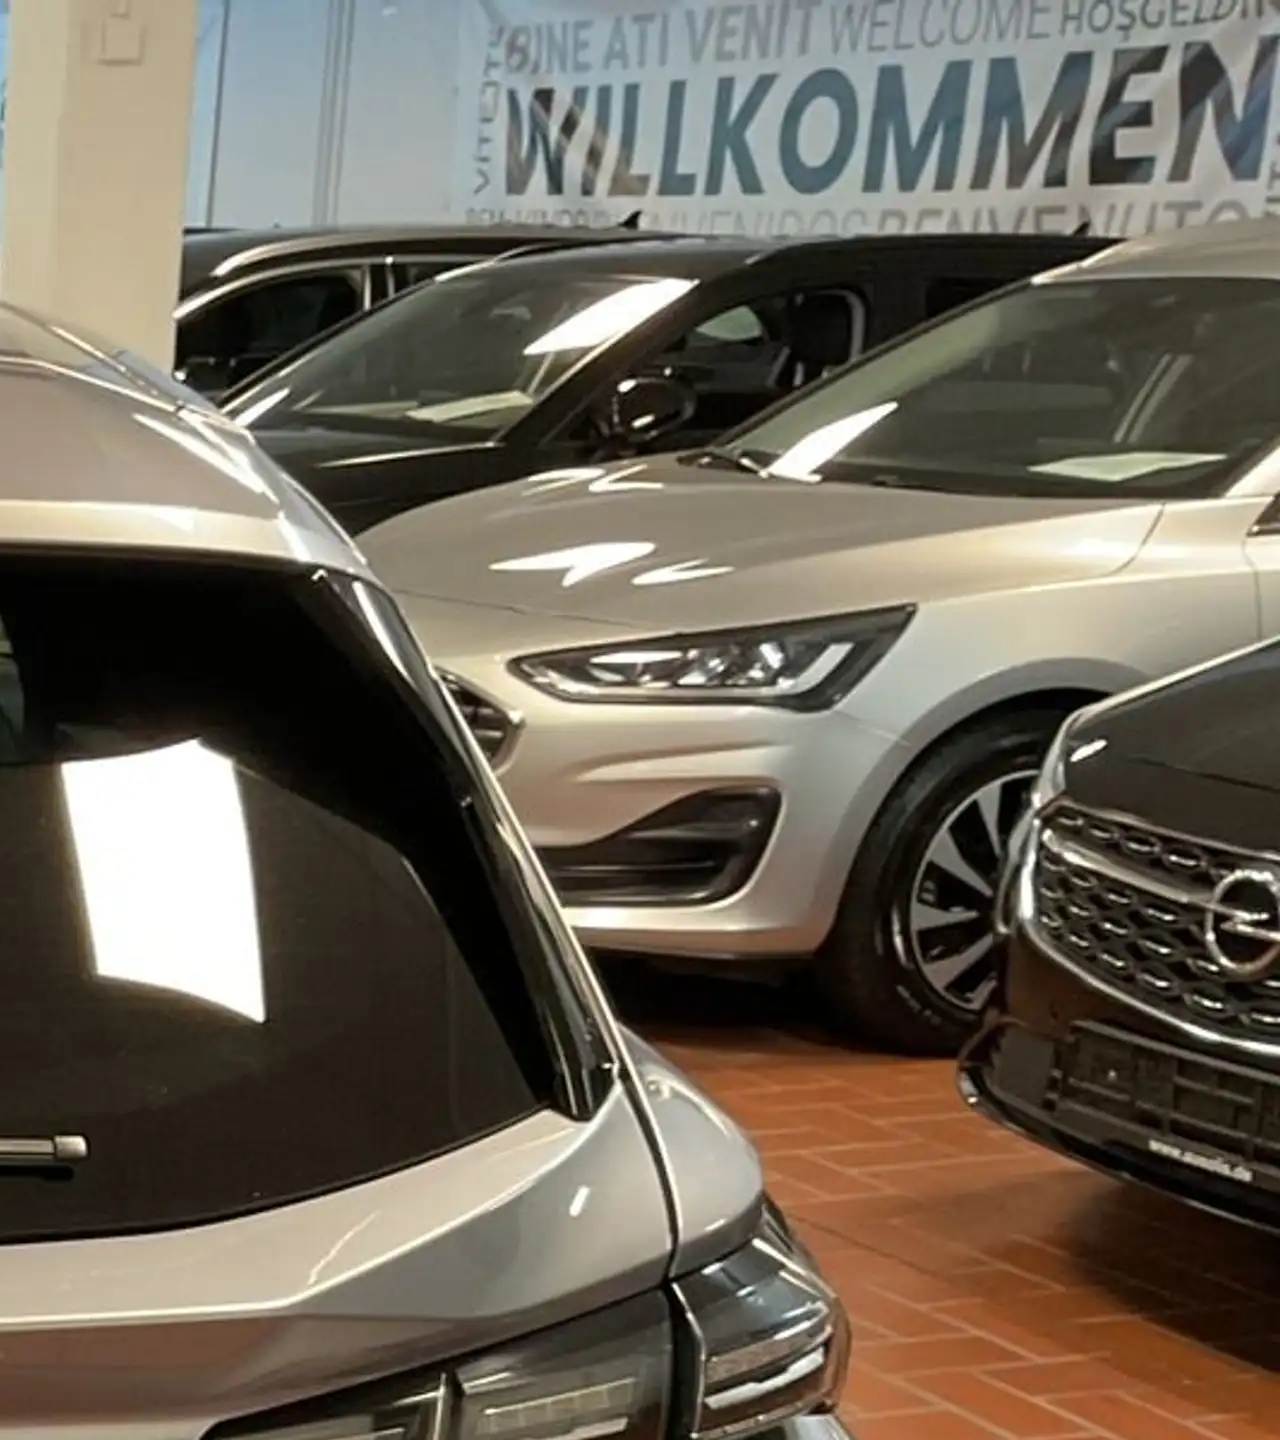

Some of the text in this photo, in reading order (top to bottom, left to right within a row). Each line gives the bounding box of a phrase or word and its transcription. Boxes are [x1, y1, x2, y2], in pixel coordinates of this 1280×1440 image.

[684, 0, 822, 63] VENIT
[830, 0, 1051, 56] WELCOME
[504, 35, 1278, 196] WILLKOMMEN
